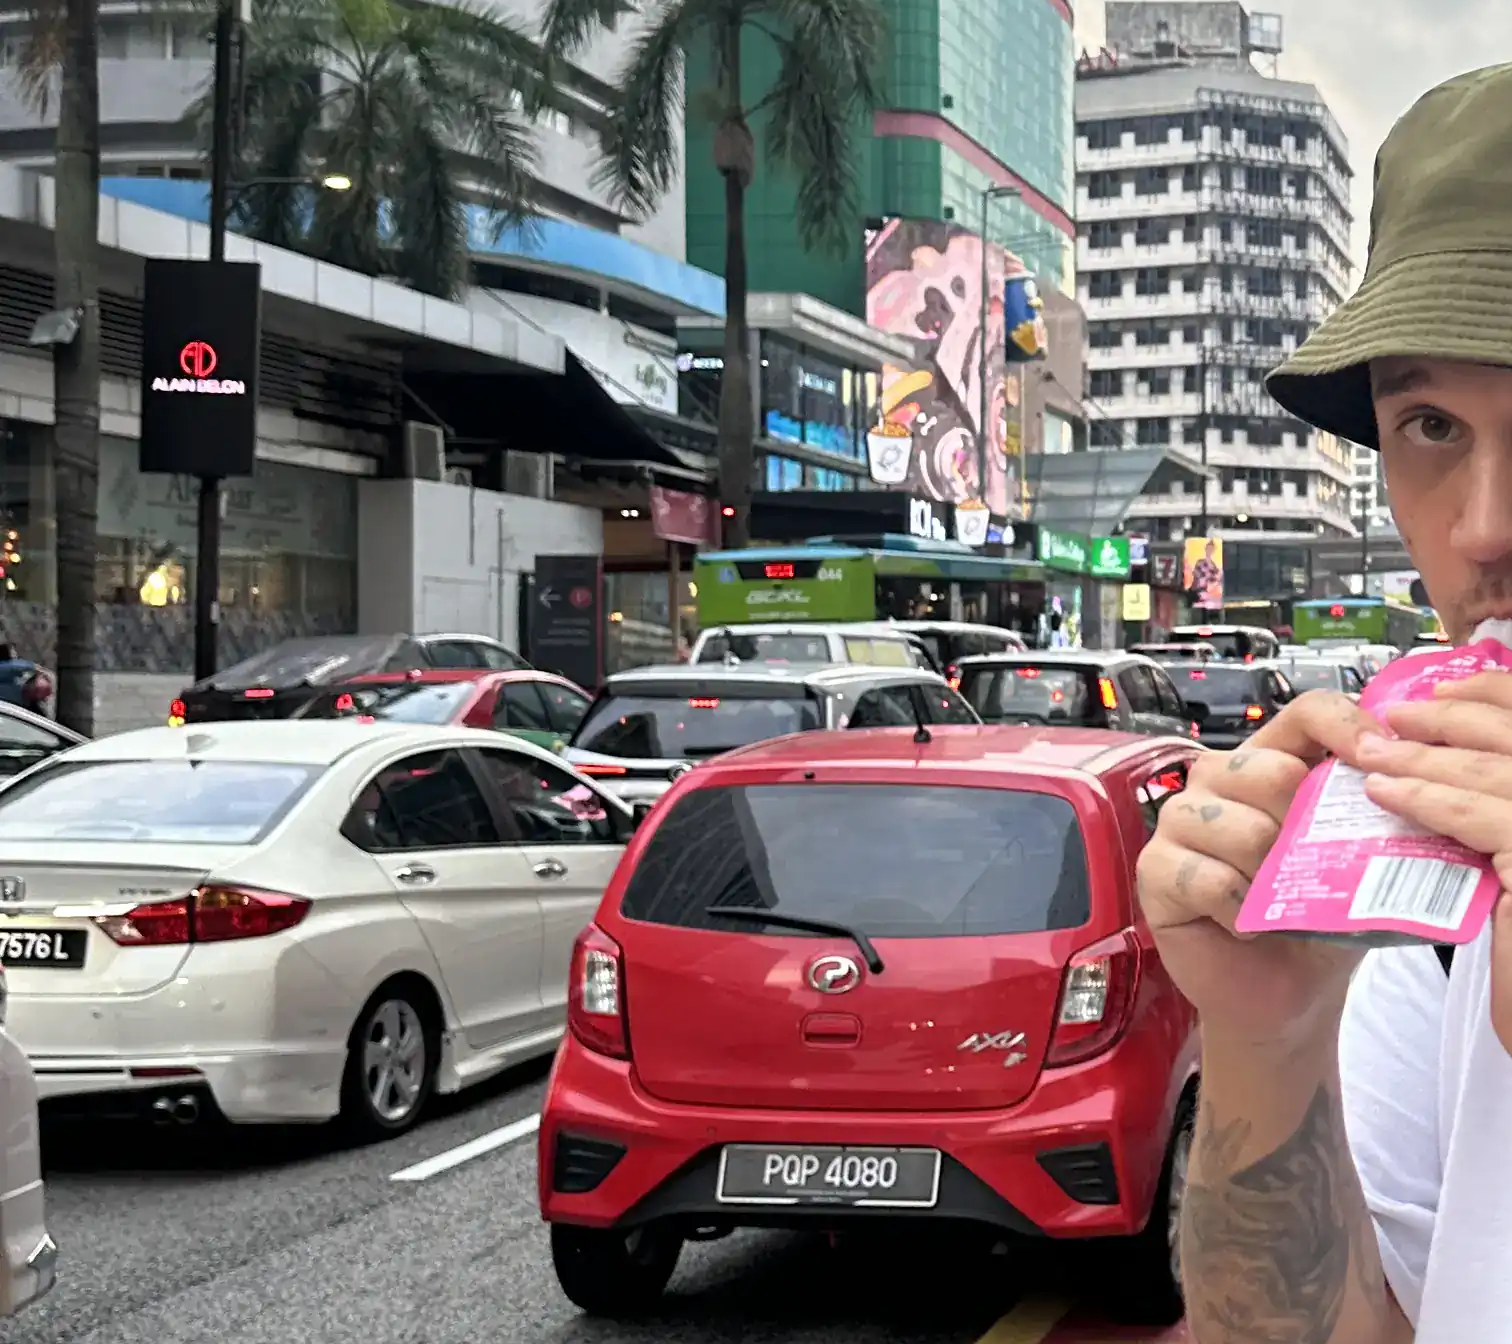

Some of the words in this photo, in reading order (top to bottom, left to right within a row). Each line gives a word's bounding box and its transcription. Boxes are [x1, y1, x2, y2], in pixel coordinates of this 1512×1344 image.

[152, 377, 196, 392] ALAIN
[763, 1154, 819, 1186] PQP
[824, 1155, 898, 1188] 4080
